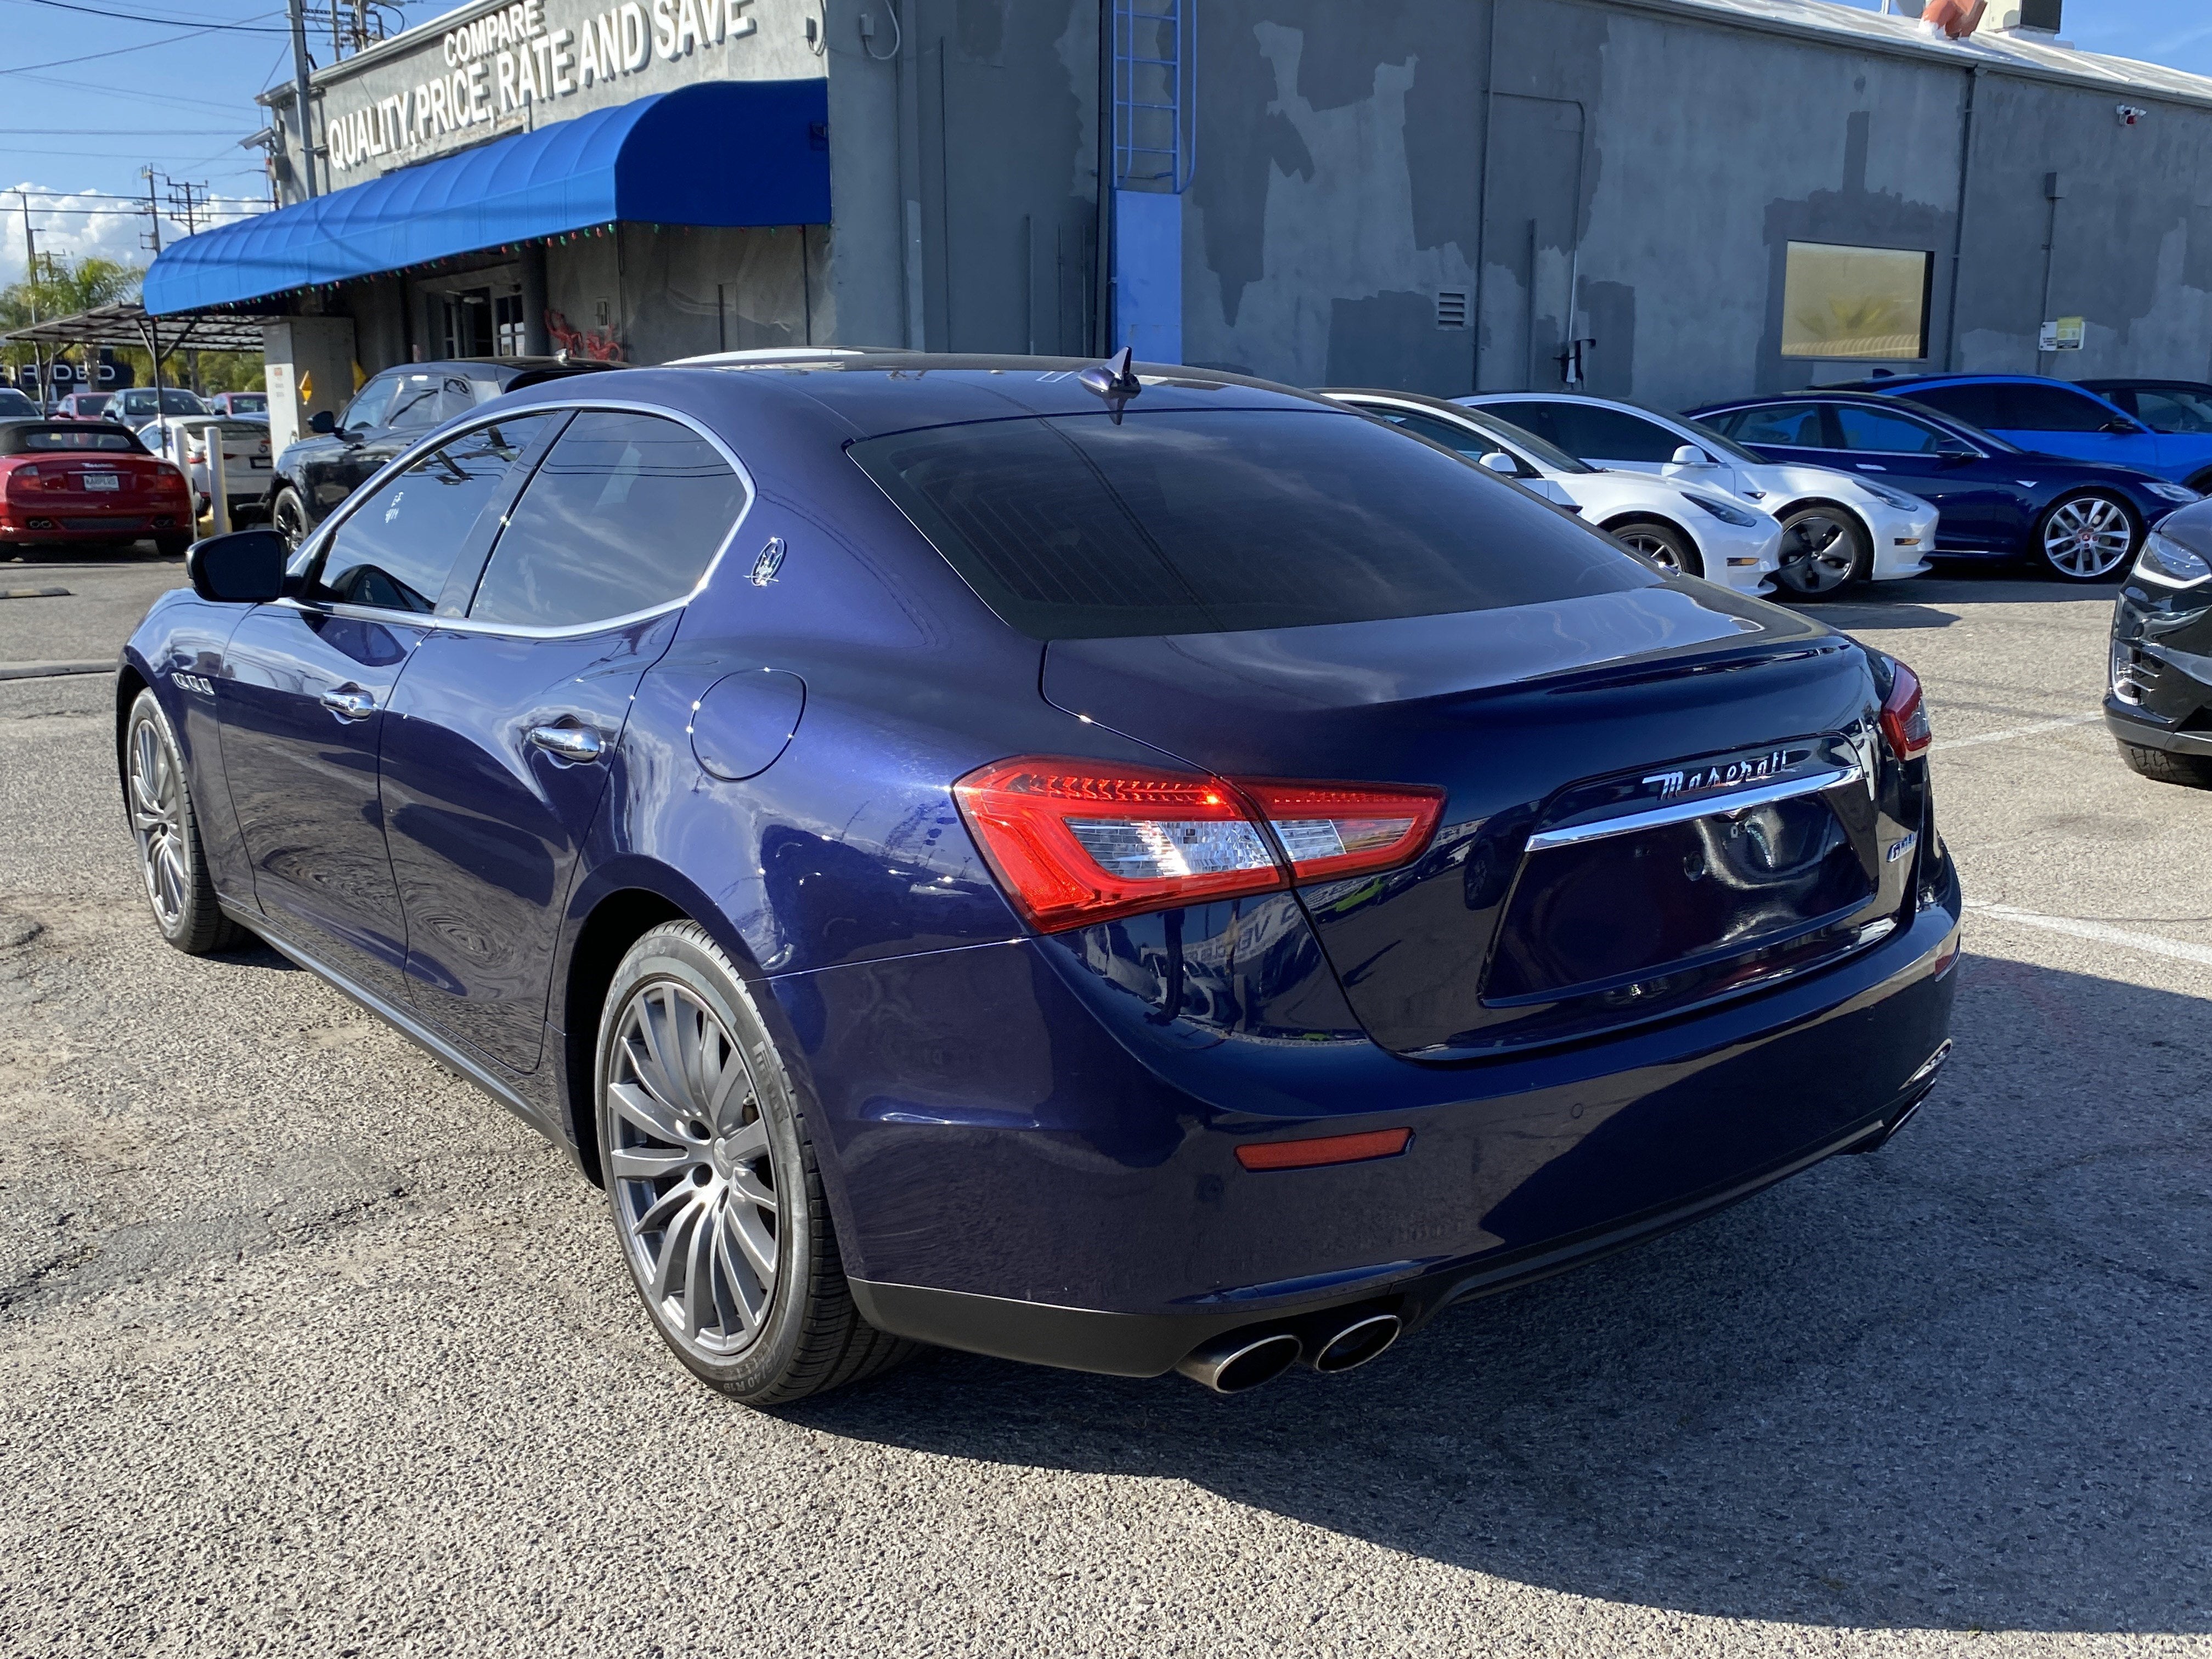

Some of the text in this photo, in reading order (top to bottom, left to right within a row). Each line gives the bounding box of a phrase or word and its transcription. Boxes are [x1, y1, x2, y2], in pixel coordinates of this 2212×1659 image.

[443, 0, 541, 67] COMPARE
[329, 0, 751, 171] QUALITY, PRICE, RATE AND SAVE
[1642, 749, 1791, 800] Maserati
